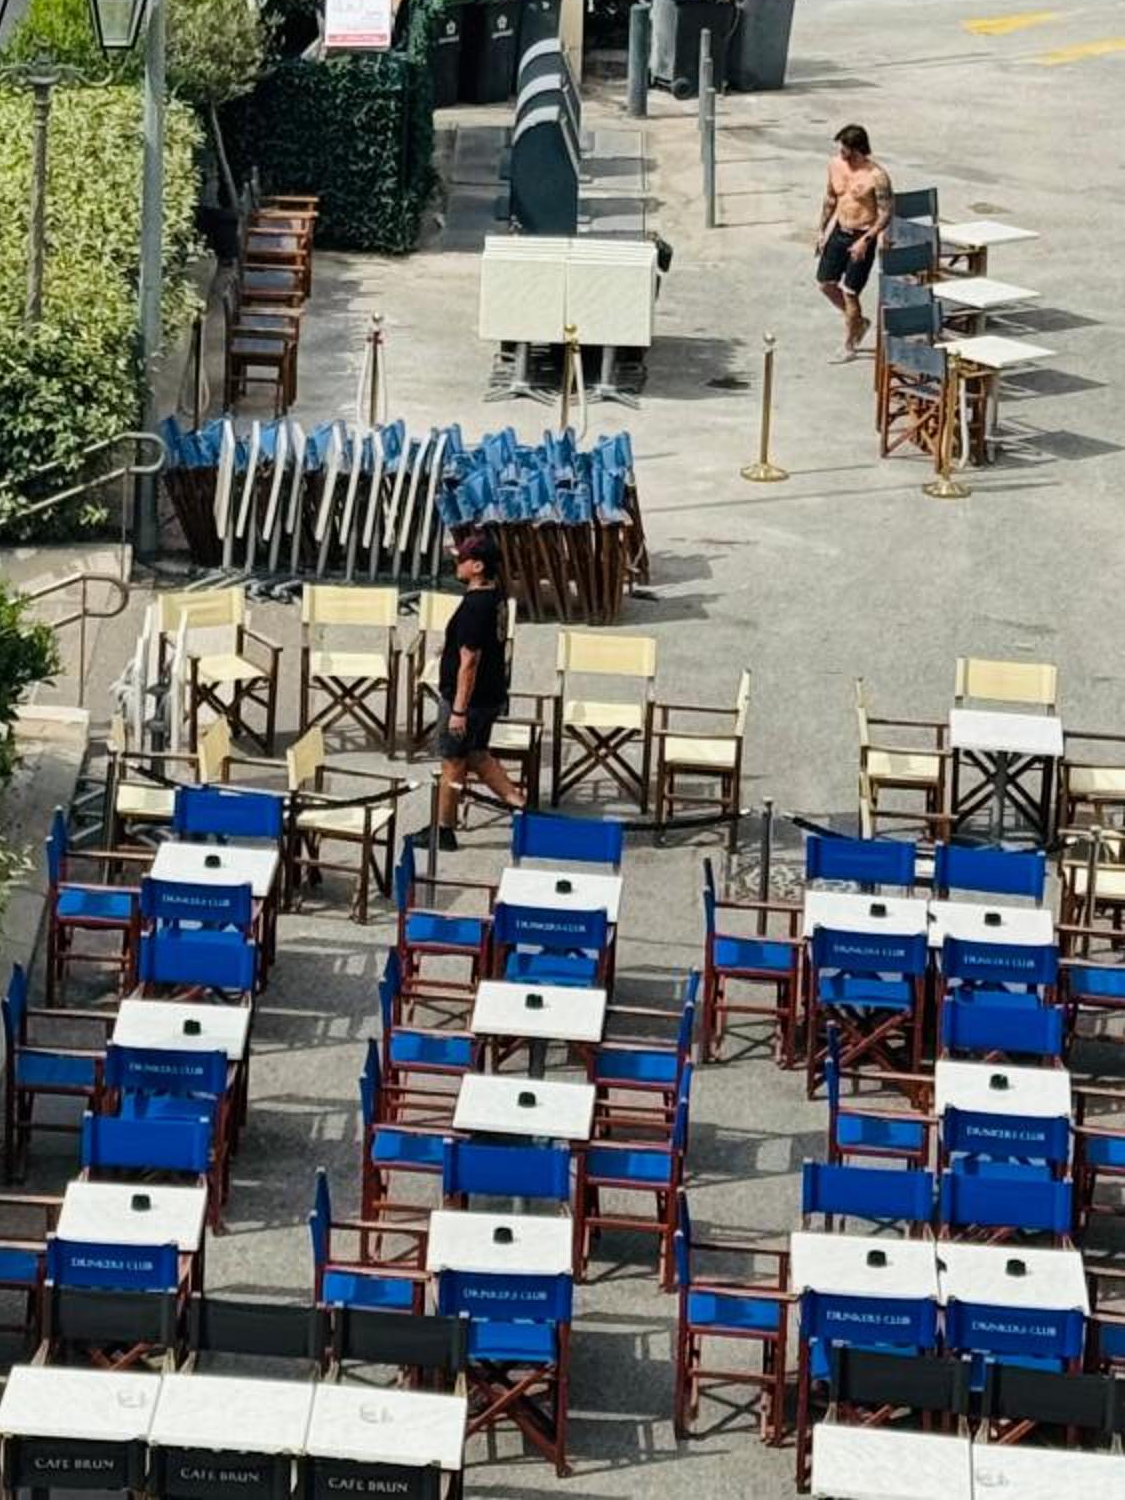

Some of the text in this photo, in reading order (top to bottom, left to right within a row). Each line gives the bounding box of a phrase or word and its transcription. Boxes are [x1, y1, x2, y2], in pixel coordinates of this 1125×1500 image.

[74, 1458, 114, 1470] BRUN
[220, 1470, 260, 1484] BRUN
[367, 1479, 408, 1494] BRUN
